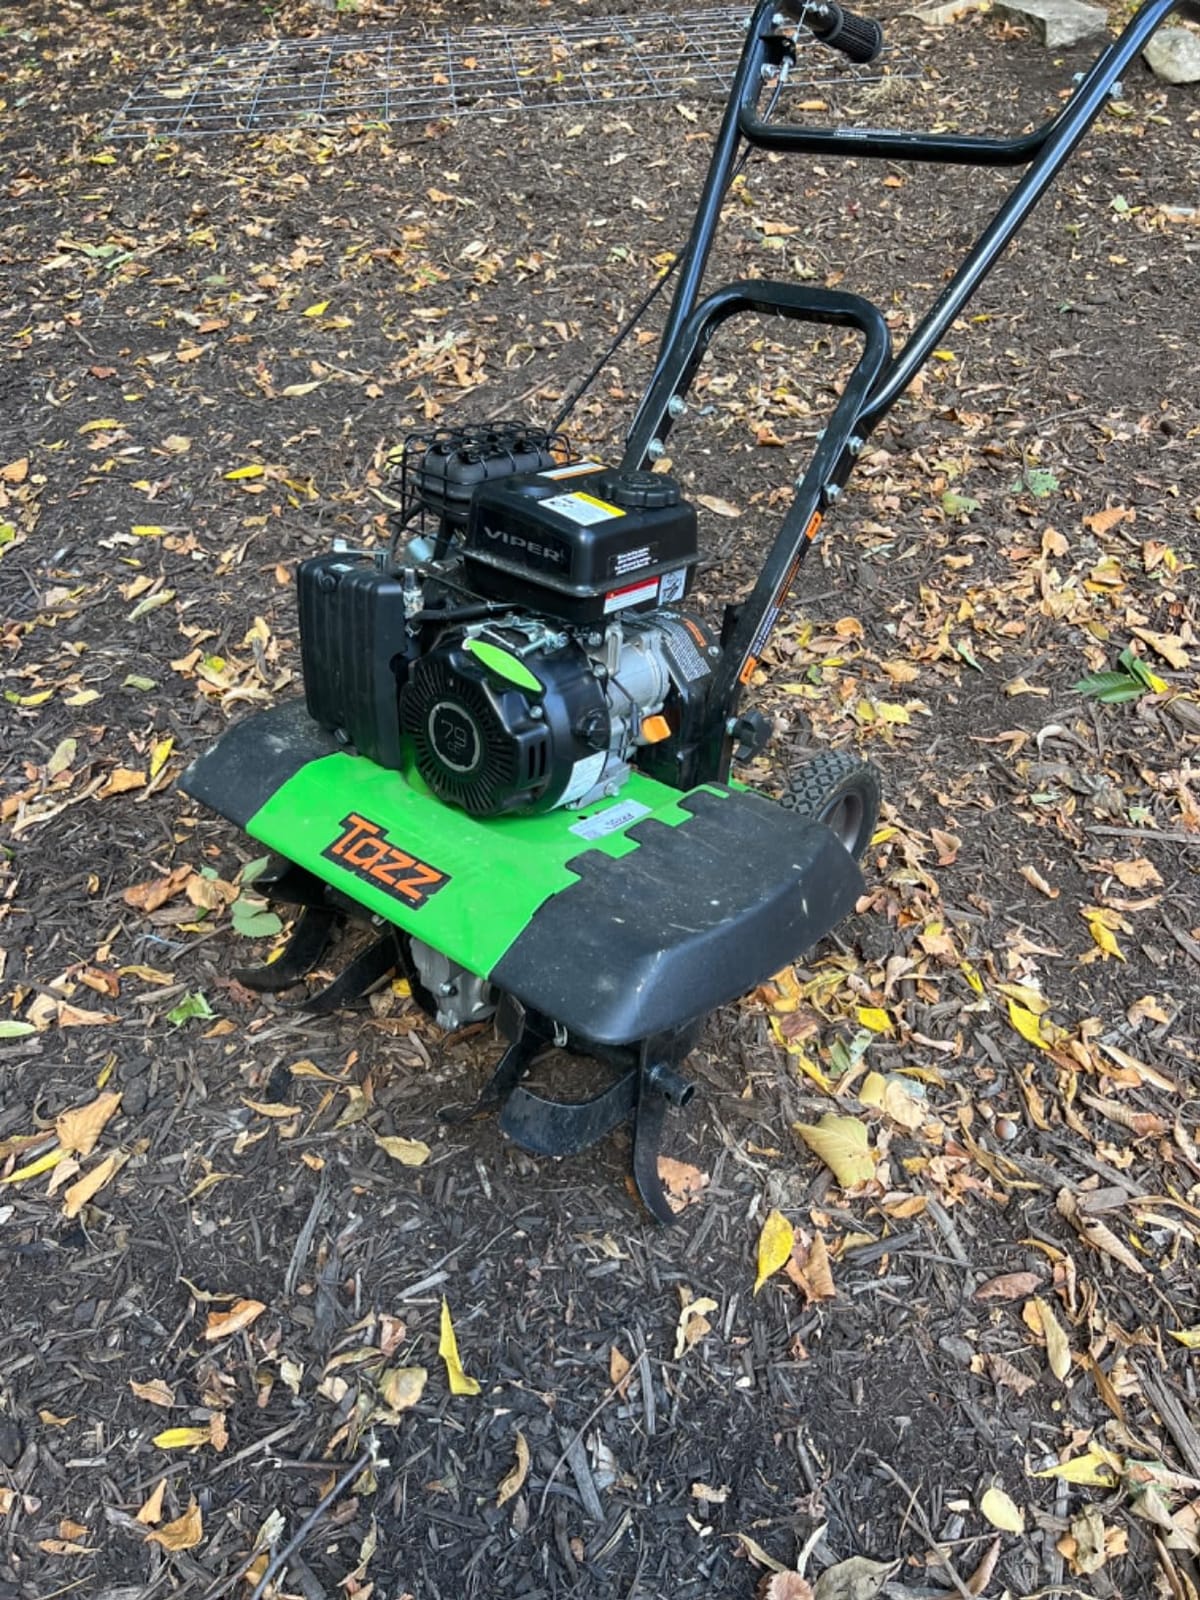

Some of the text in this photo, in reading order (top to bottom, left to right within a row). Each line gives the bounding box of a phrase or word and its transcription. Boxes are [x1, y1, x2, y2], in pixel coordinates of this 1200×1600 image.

[484, 526, 560, 562] VIPER
[441, 719, 467, 748] 79
[331, 813, 444, 901] Tazz
